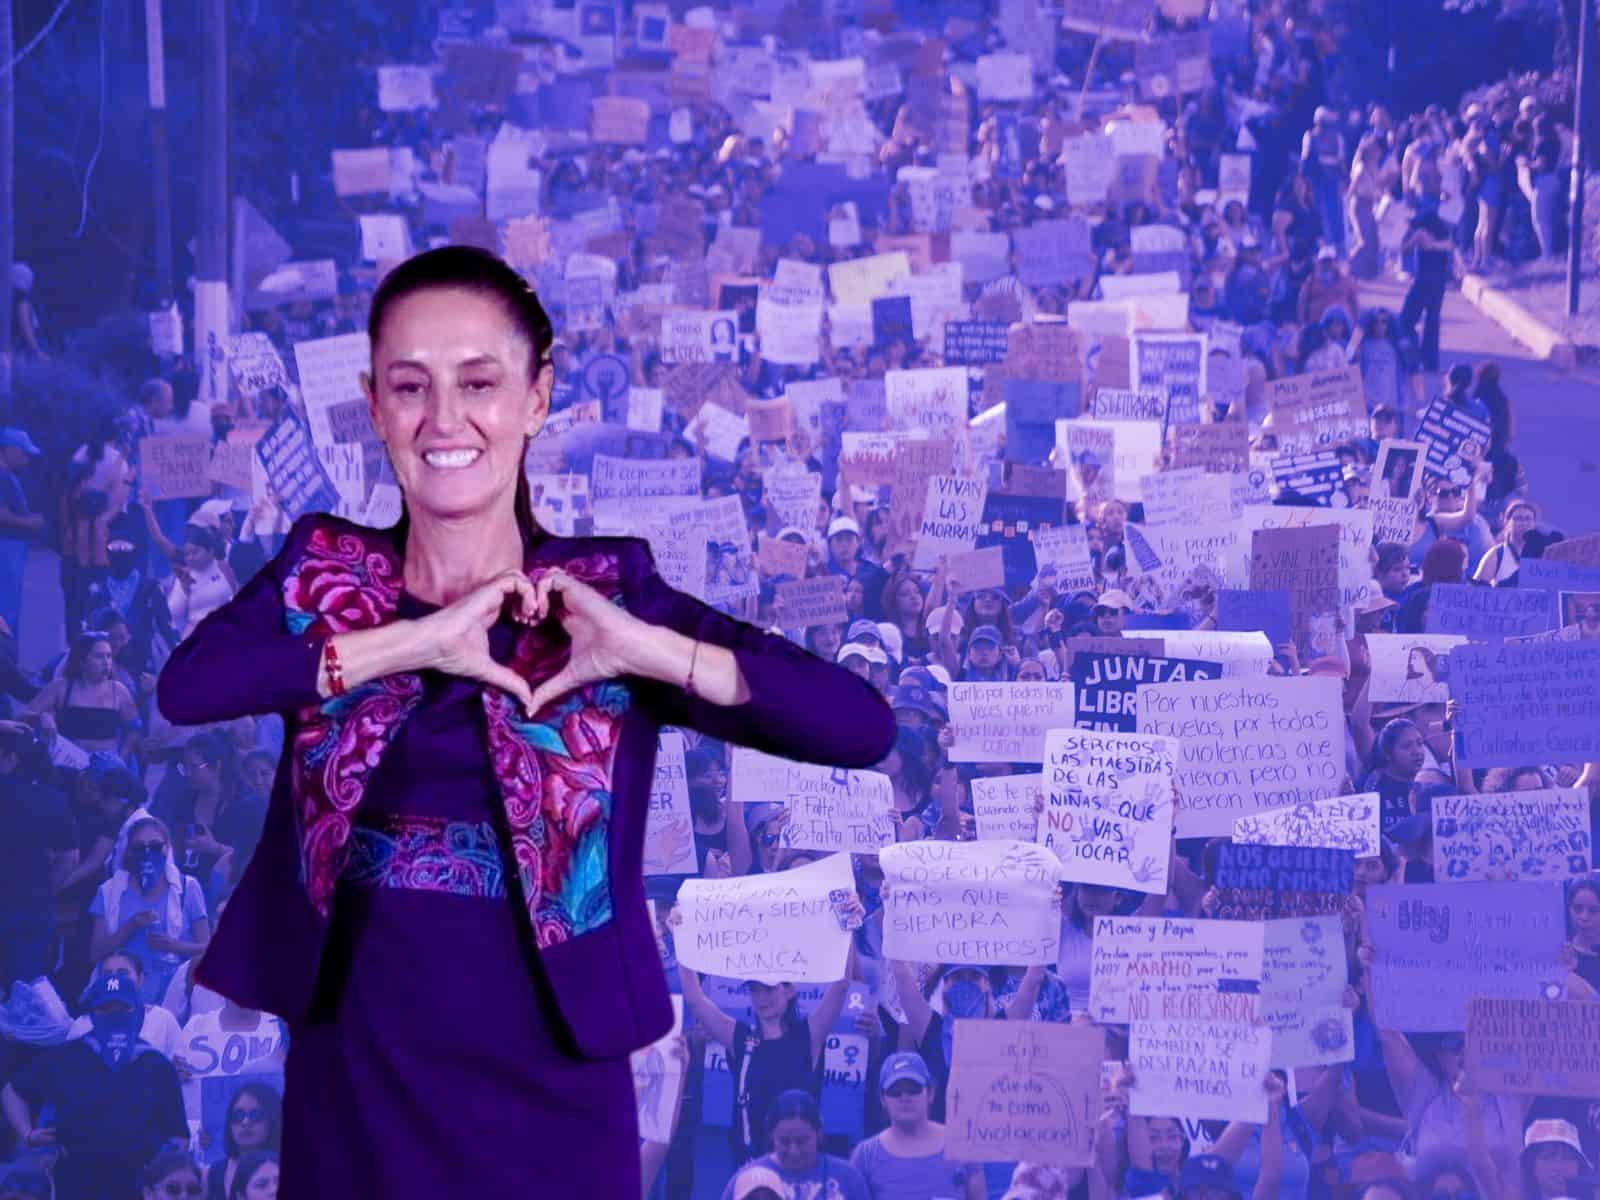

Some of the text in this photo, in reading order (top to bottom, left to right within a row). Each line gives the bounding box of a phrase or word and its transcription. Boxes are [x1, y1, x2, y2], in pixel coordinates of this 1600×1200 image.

[937, 478, 985, 498] VIVAN
[938, 499, 968, 521] LAS
[922, 520, 981, 540] MORRAS
[1084, 654, 1209, 687] JUNTAS
[1079, 688, 1137, 715] LIBR
[1142, 687, 1280, 713] Por nuestras
[1233, 719, 1260, 739] por
[1269, 710, 1329, 731] todas
[1065, 736, 1154, 753] SEREMOS
[1182, 739, 1332, 765] violencias que
[1050, 753, 1174, 777] LAS MAESTRAS
[1249, 761, 1298, 787] pero
[1306, 760, 1338, 781] no
[1053, 768, 1119, 791] DE LAS
[1050, 788, 1156, 822] NIÑAS QUE
[1048, 810, 1123, 842] NO VAS
[1044, 833, 1130, 865] A TOCAR
[961, 888, 1009, 907] QUE
[892, 910, 1010, 934] SIEMBRA
[1148, 923, 1156, 943] y
[696, 927, 769, 951] MIEDO
[1126, 961, 1192, 978] MARCHO
[1128, 993, 1150, 1021] NO
[1174, 1075, 1234, 1098] AMIGOS
